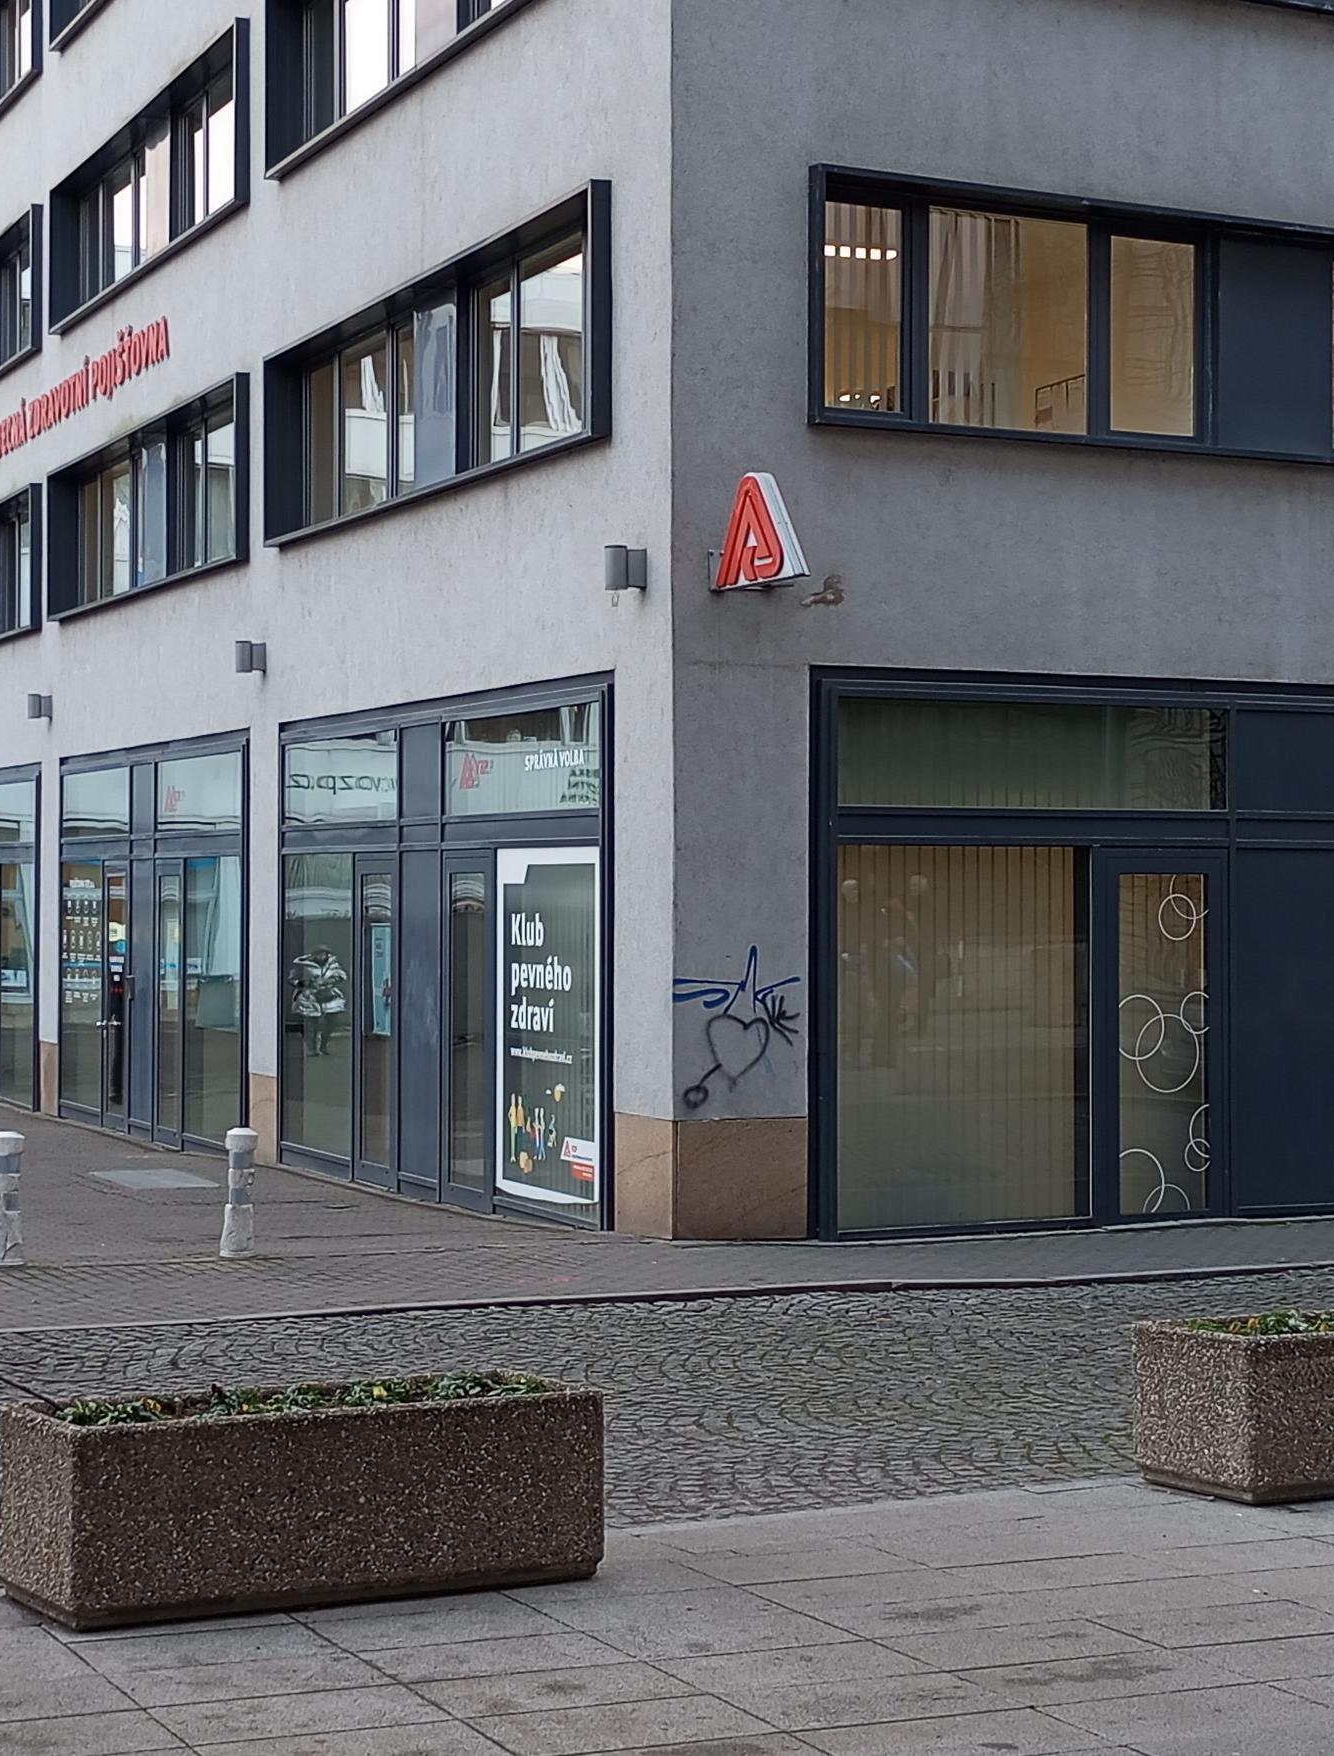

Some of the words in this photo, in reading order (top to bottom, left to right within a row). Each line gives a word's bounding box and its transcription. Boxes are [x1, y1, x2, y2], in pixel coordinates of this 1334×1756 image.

[28, 355, 90, 440] ZDRAVOTNÍ
[91, 315, 170, 402] POJIŠŤOVNA
[524, 747, 559, 771] SPRÁVNÁ
[559, 748, 585, 767] VOLBA
[510, 912, 545, 947] Klub
[510, 955, 572, 996] pevného
[510, 996, 555, 1033] zdraví
